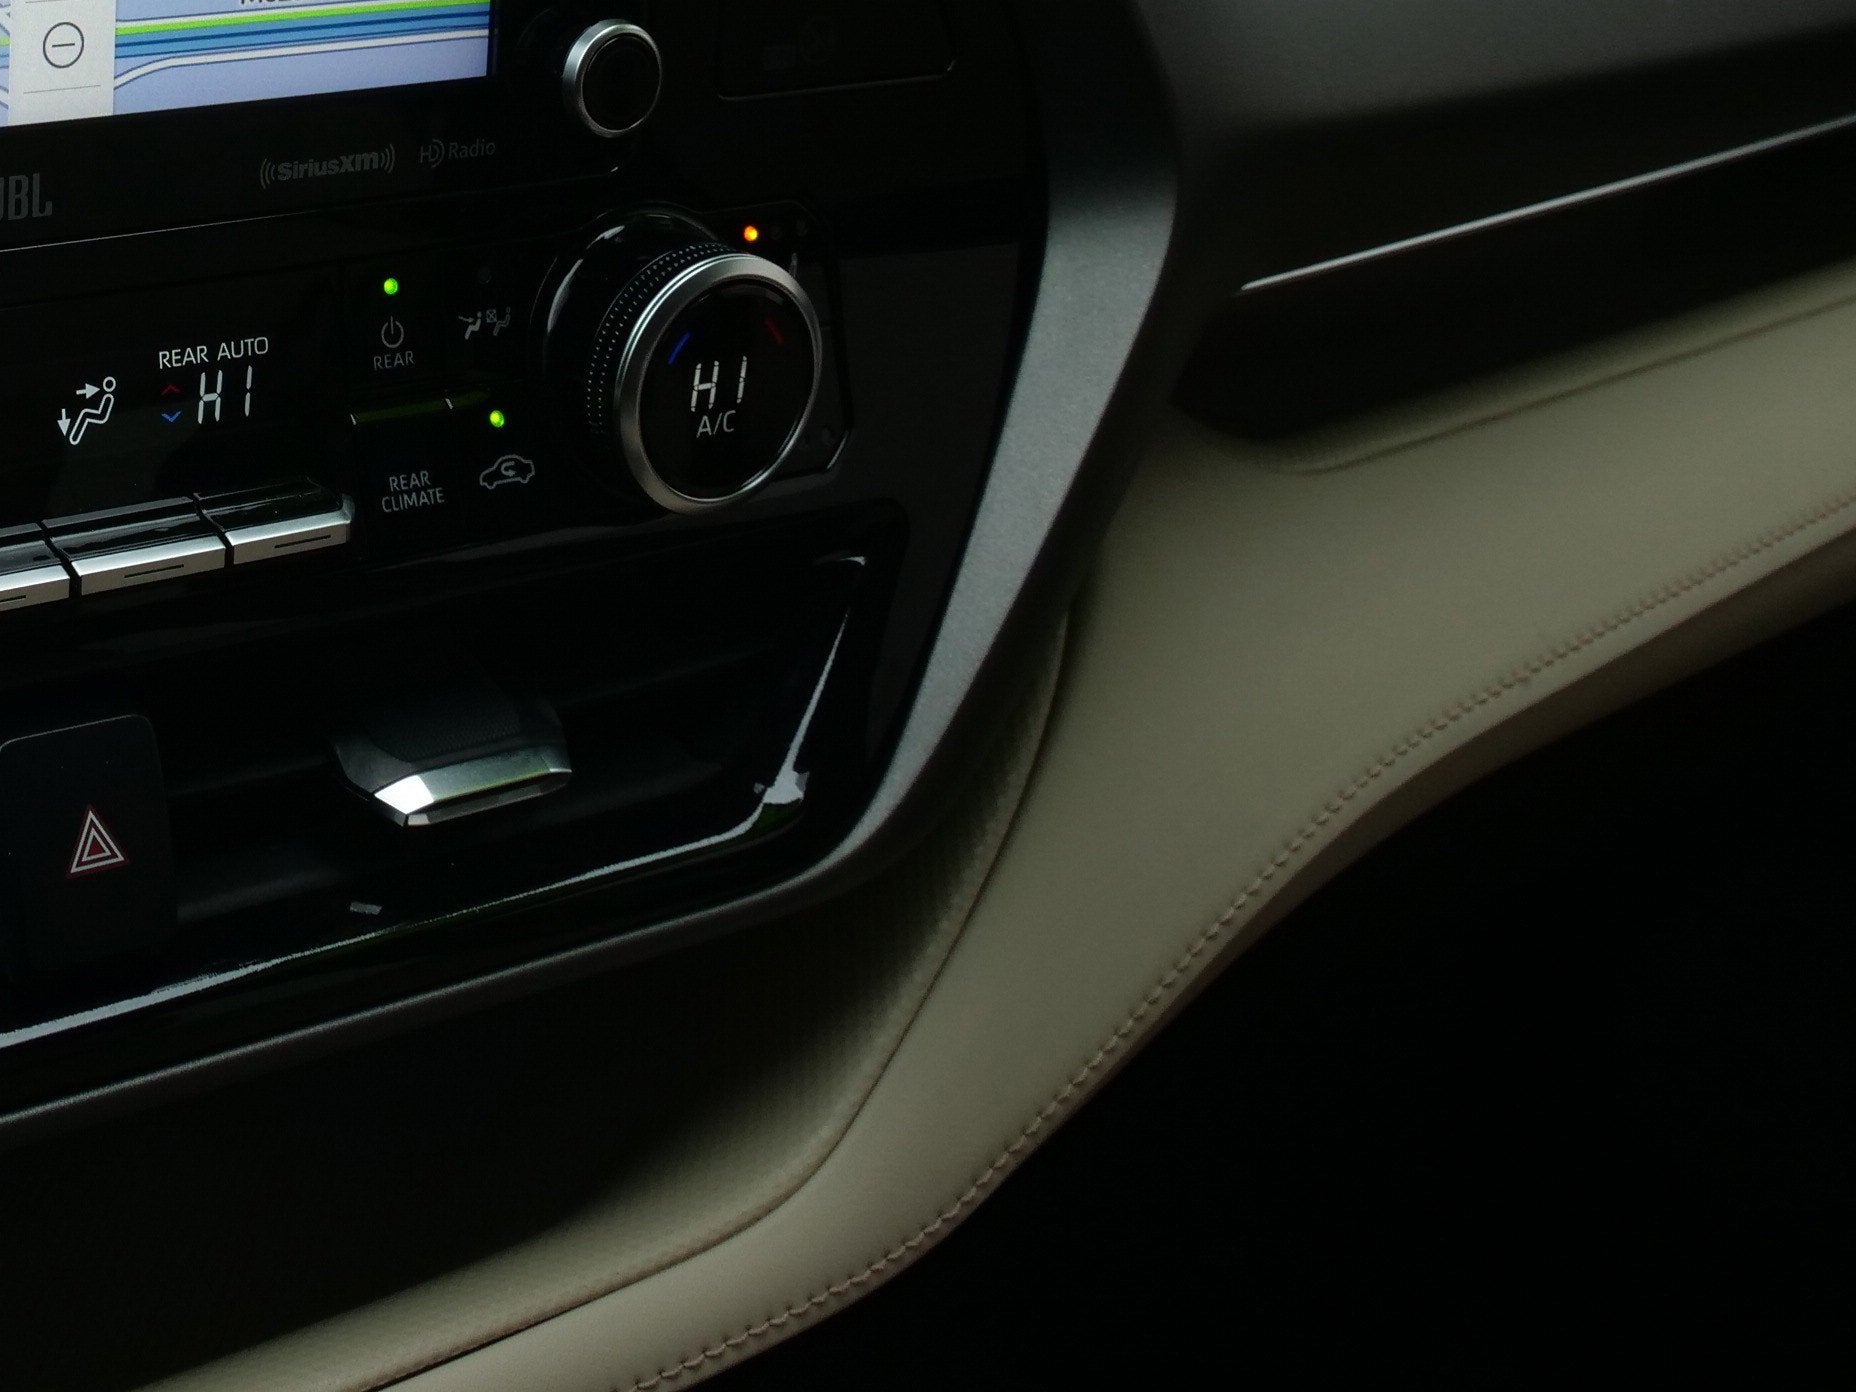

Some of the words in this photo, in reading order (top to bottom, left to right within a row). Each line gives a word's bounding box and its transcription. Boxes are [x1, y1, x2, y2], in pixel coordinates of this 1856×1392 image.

[448, 139, 497, 161] Radio
[158, 345, 209, 369] REAR
[216, 336, 270, 363] AUTO
[373, 348, 415, 371] REAR
[696, 409, 738, 439] A/C
[389, 470, 432, 491] REAR
[381, 486, 445, 514] CLIMATE
